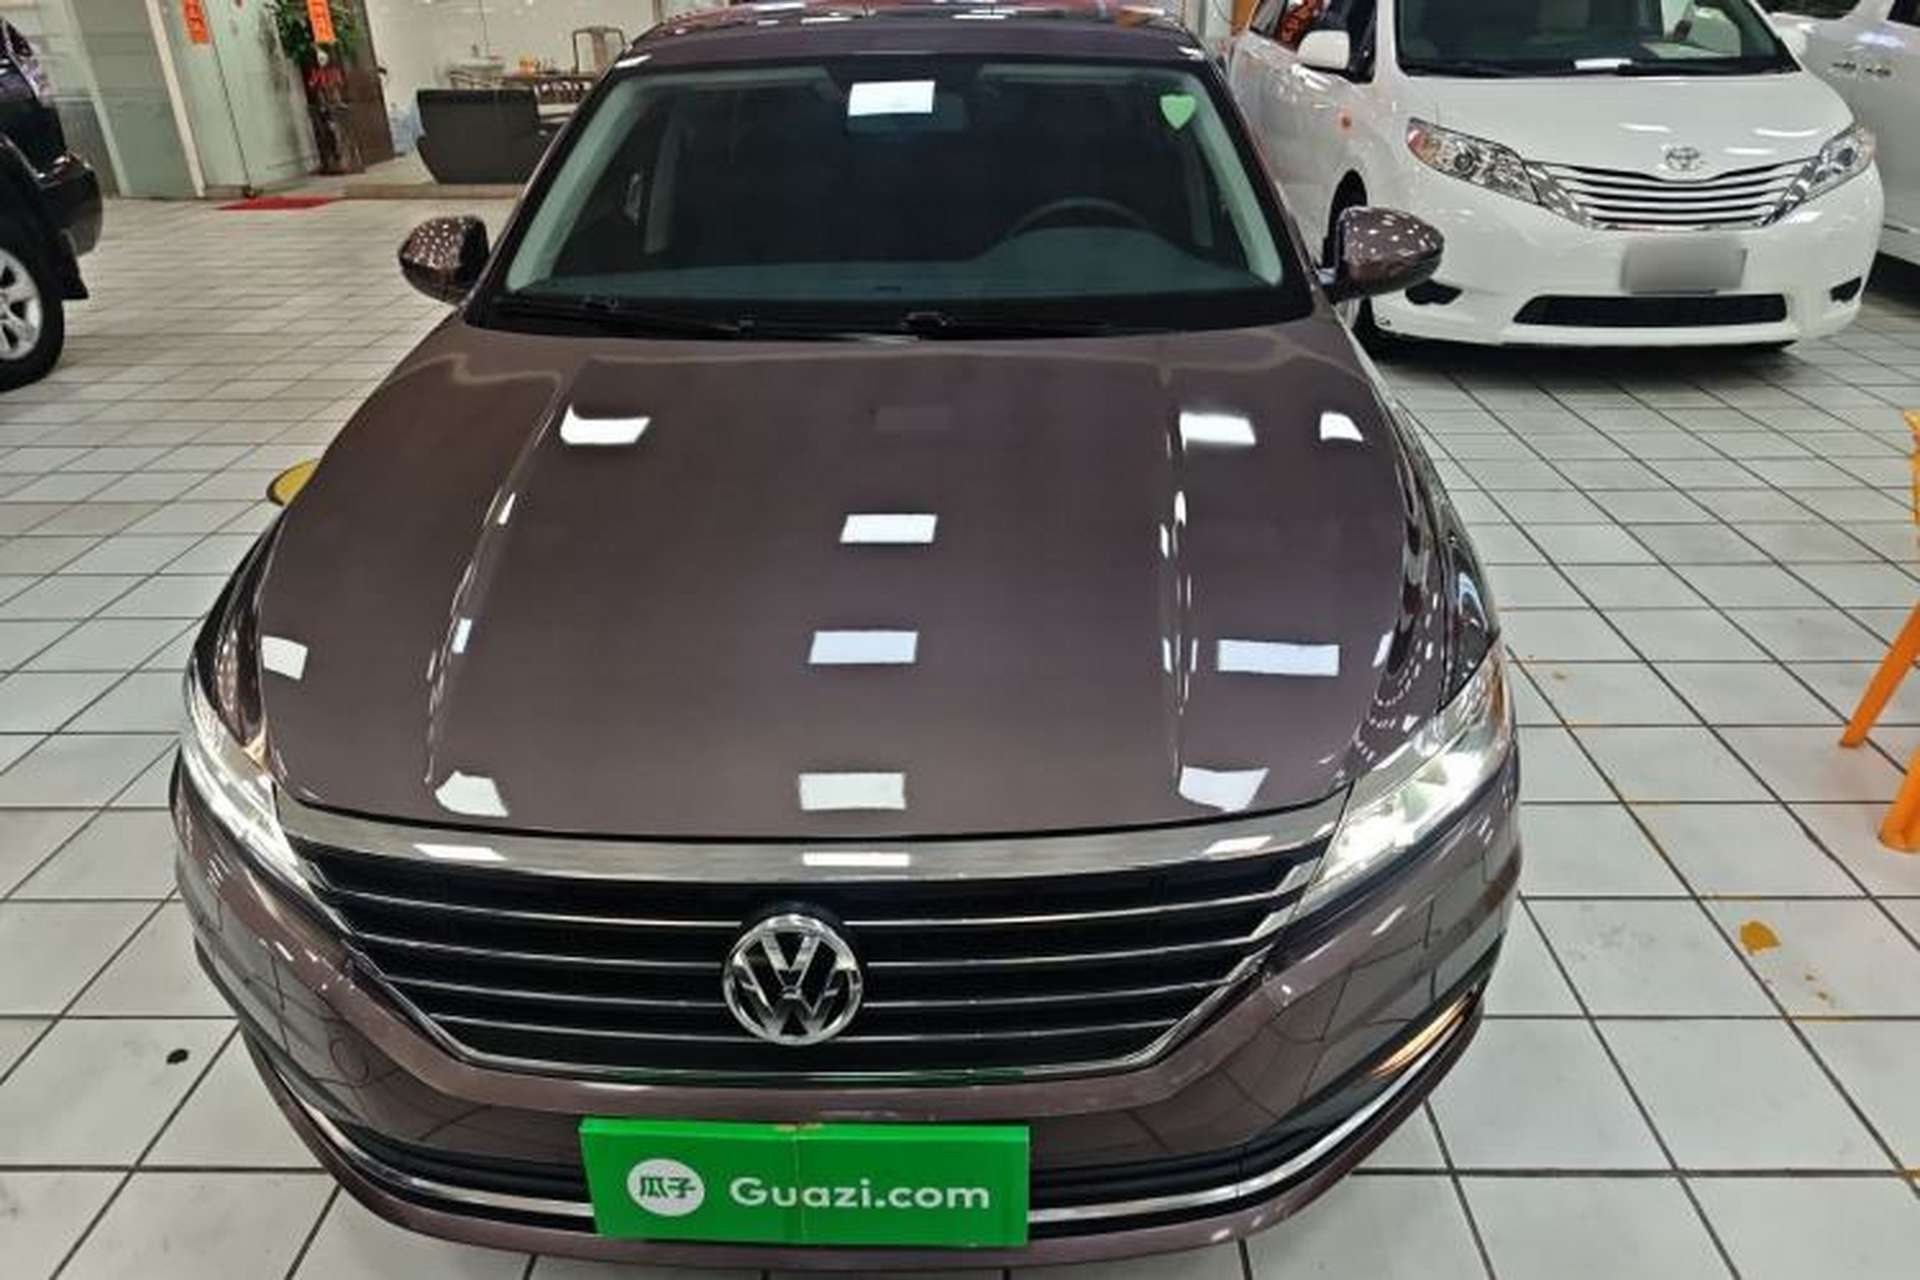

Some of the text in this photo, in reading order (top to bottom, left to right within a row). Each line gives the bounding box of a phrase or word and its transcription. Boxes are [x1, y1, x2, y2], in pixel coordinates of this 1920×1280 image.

[727, 919, 859, 1041] VW
[640, 1176, 697, 1199] 瓜子
[729, 1177, 990, 1208] Guazi.com
